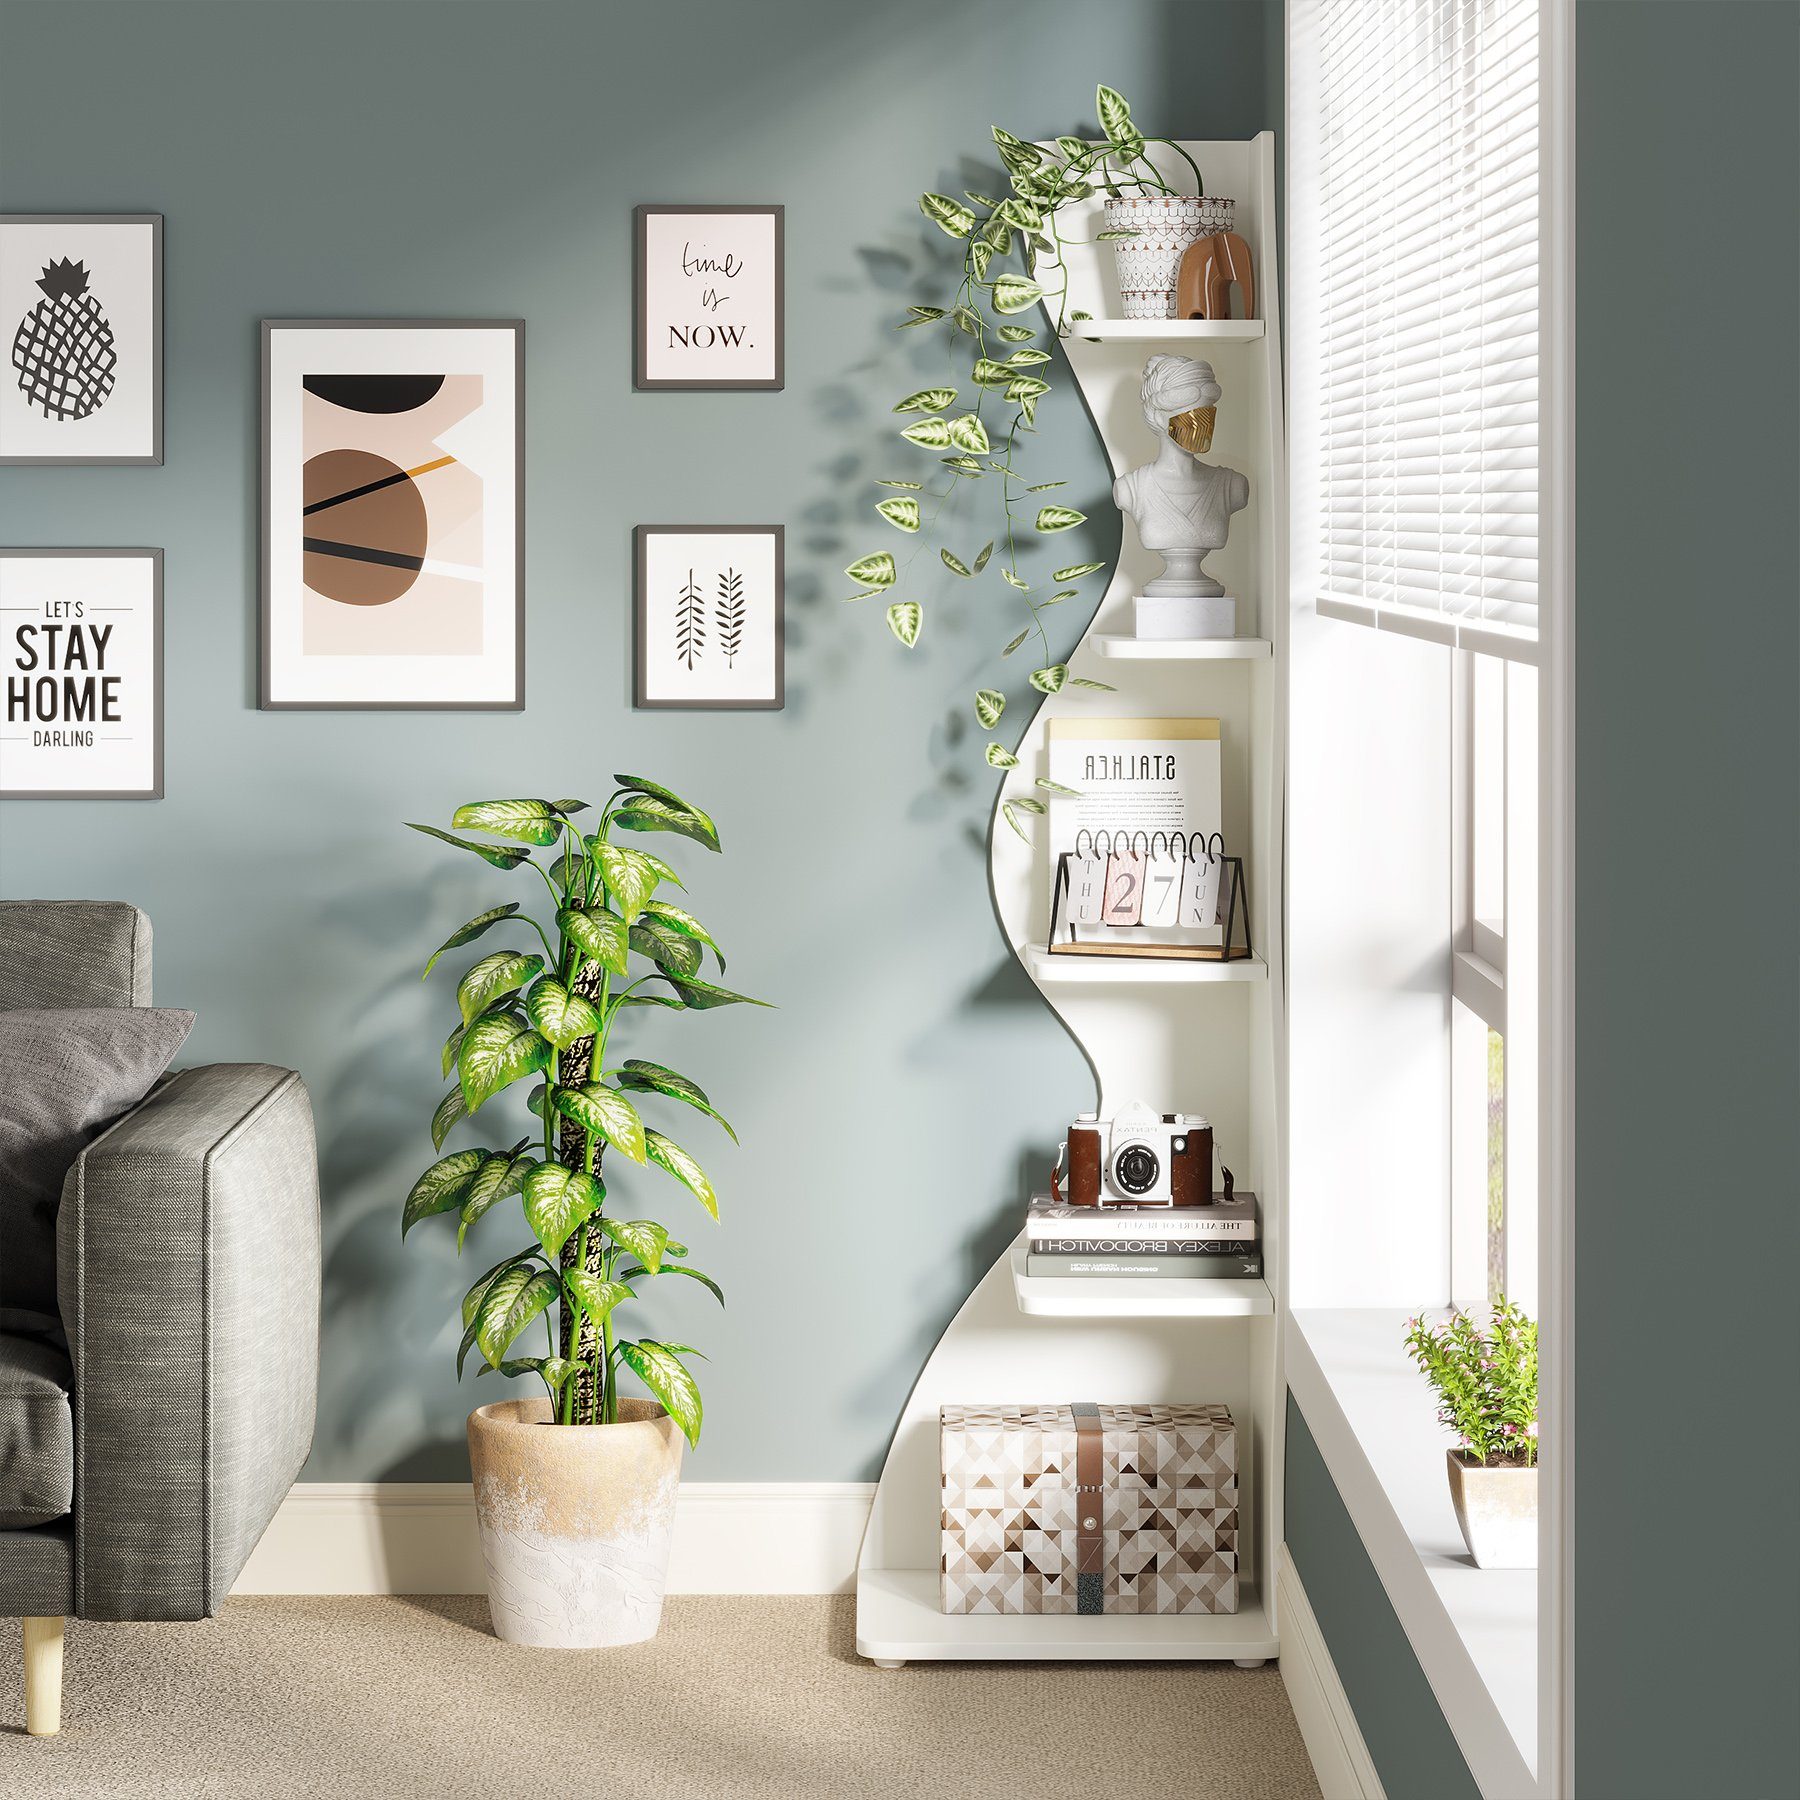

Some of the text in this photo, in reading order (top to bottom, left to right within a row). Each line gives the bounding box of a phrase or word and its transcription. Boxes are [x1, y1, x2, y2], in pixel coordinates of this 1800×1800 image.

[682, 241, 743, 278] time
[702, 282, 730, 312] is
[667, 325, 755, 349] NOW.
[45, 601, 84, 618] LET'S
[15, 624, 114, 671] STAY
[7, 676, 122, 722] HOME
[33, 730, 94, 747] DARLING
